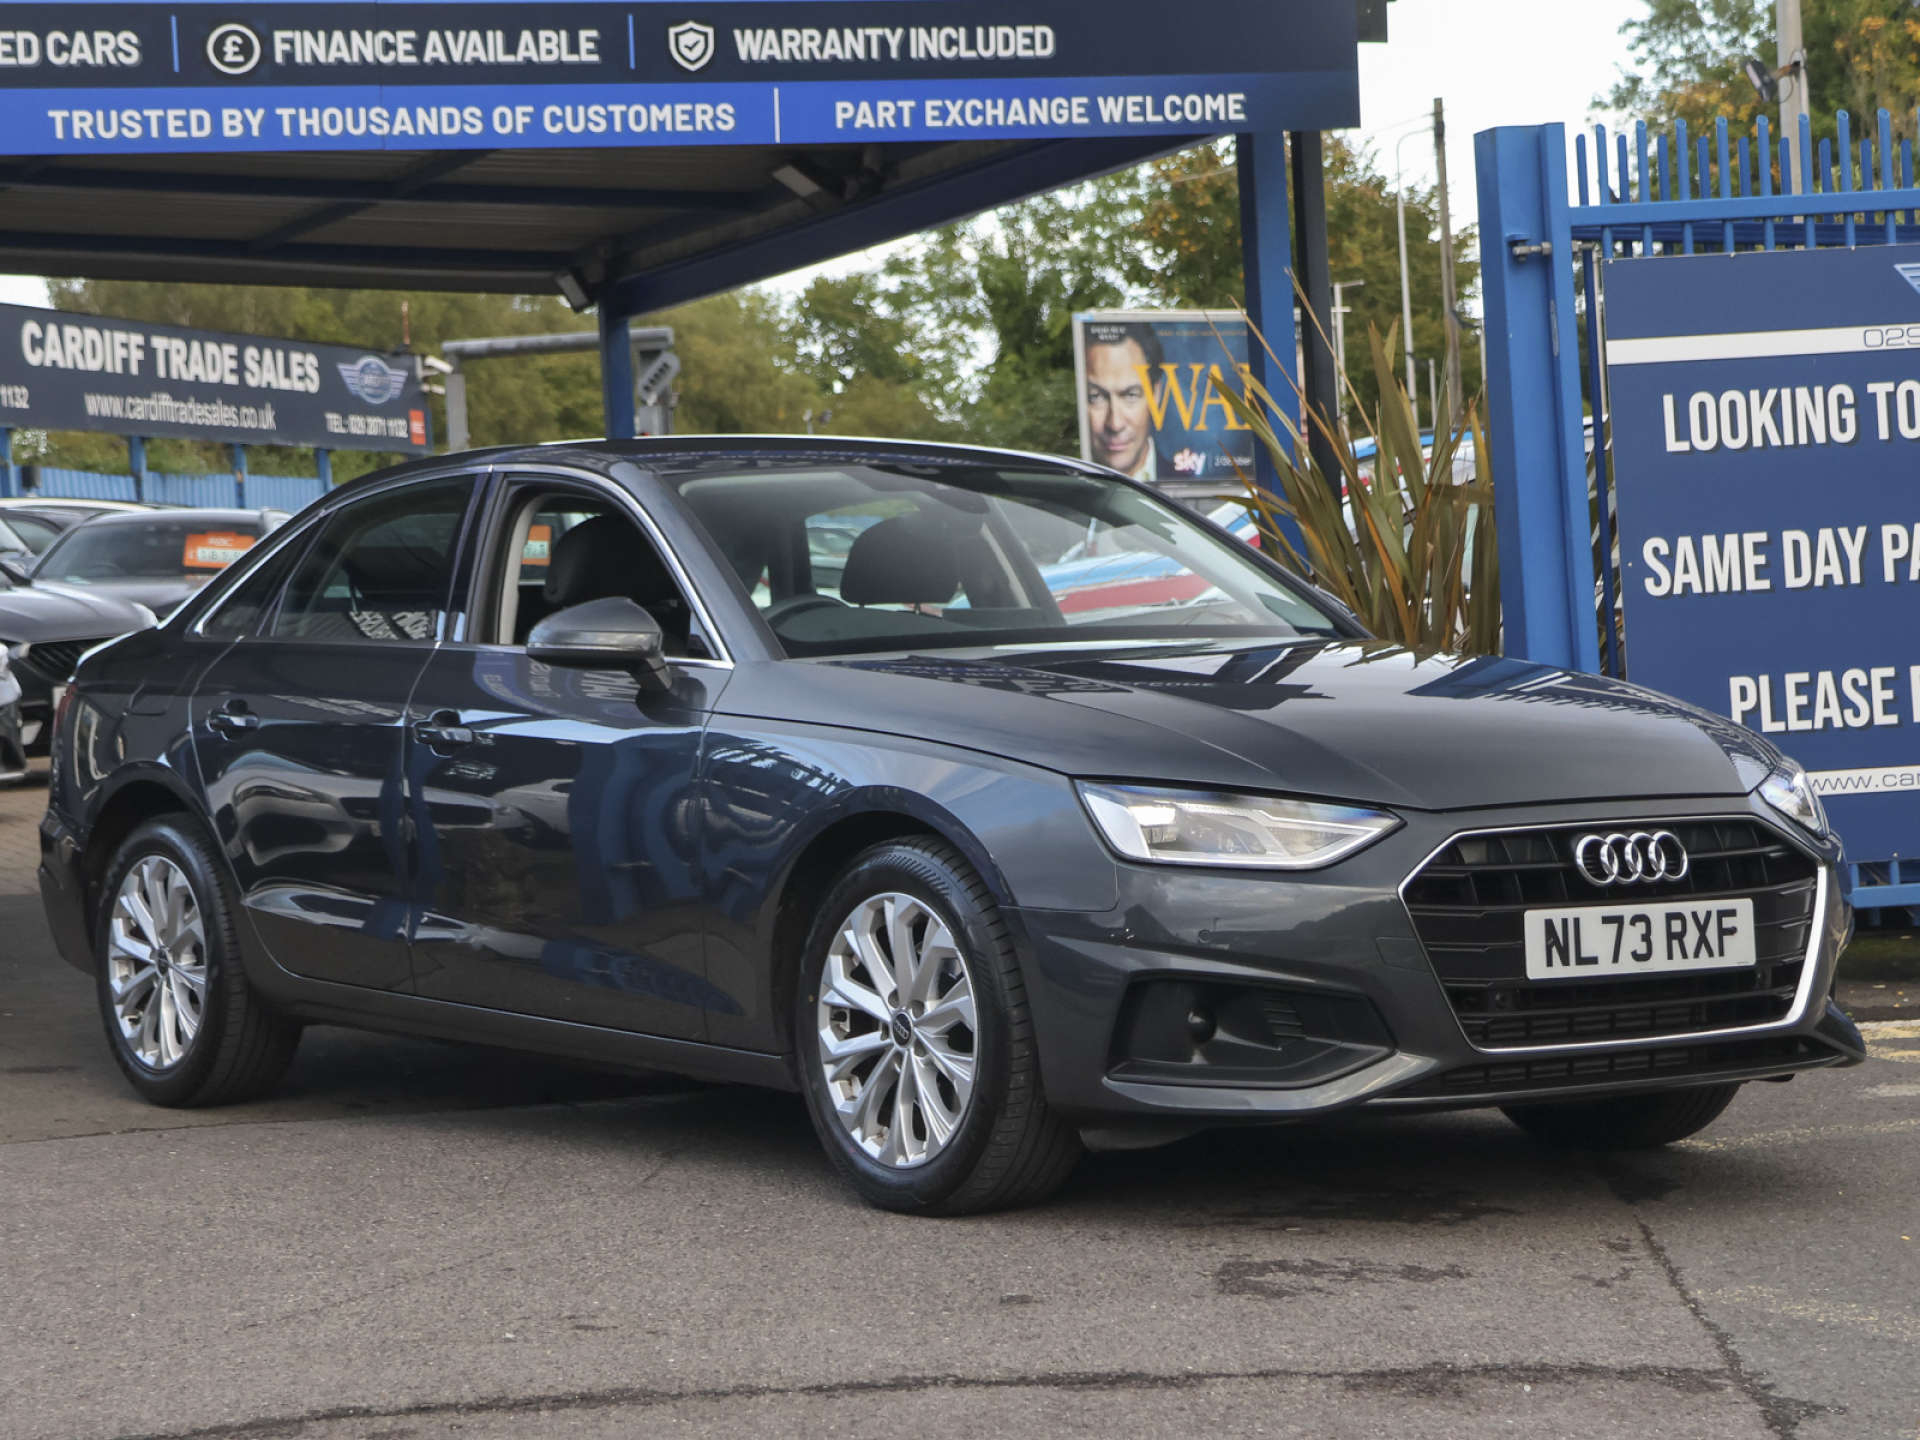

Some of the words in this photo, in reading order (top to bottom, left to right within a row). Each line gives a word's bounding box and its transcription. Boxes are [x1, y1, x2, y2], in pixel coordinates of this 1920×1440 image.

[0, 31, 40, 65] ED
[46, 30, 140, 66] CARS
[273, 30, 417, 65] FINANCE
[423, 29, 600, 63] AVAILABLE
[733, 27, 904, 61] WARRANTY
[909, 25, 1055, 59] INCLUDED
[47, 108, 212, 140] TRUSTED
[221, 108, 265, 138] BY
[275, 106, 484, 137] THOUSANDS
[492, 105, 534, 135] OF
[543, 103, 735, 134] CUSTOMERS
[835, 100, 916, 129] PART
[924, 96, 1090, 127] EXCHANGE
[1097, 93, 1246, 124] WELCOME
[21, 320, 145, 376] CARDIFF
[150, 335, 239, 385] TRADE
[244, 346, 320, 394] SALES
[1662, 383, 1856, 452] LOOKING
[1866, 380, 1920, 440] TO
[1173, 448, 1207, 475] sky
[1642, 531, 1771, 597] SAME
[1782, 525, 1867, 589] DAY
[1726, 666, 1899, 734] PLEASE
[1544, 913, 1653, 968] NL73
[1665, 908, 1737, 961] RXF
